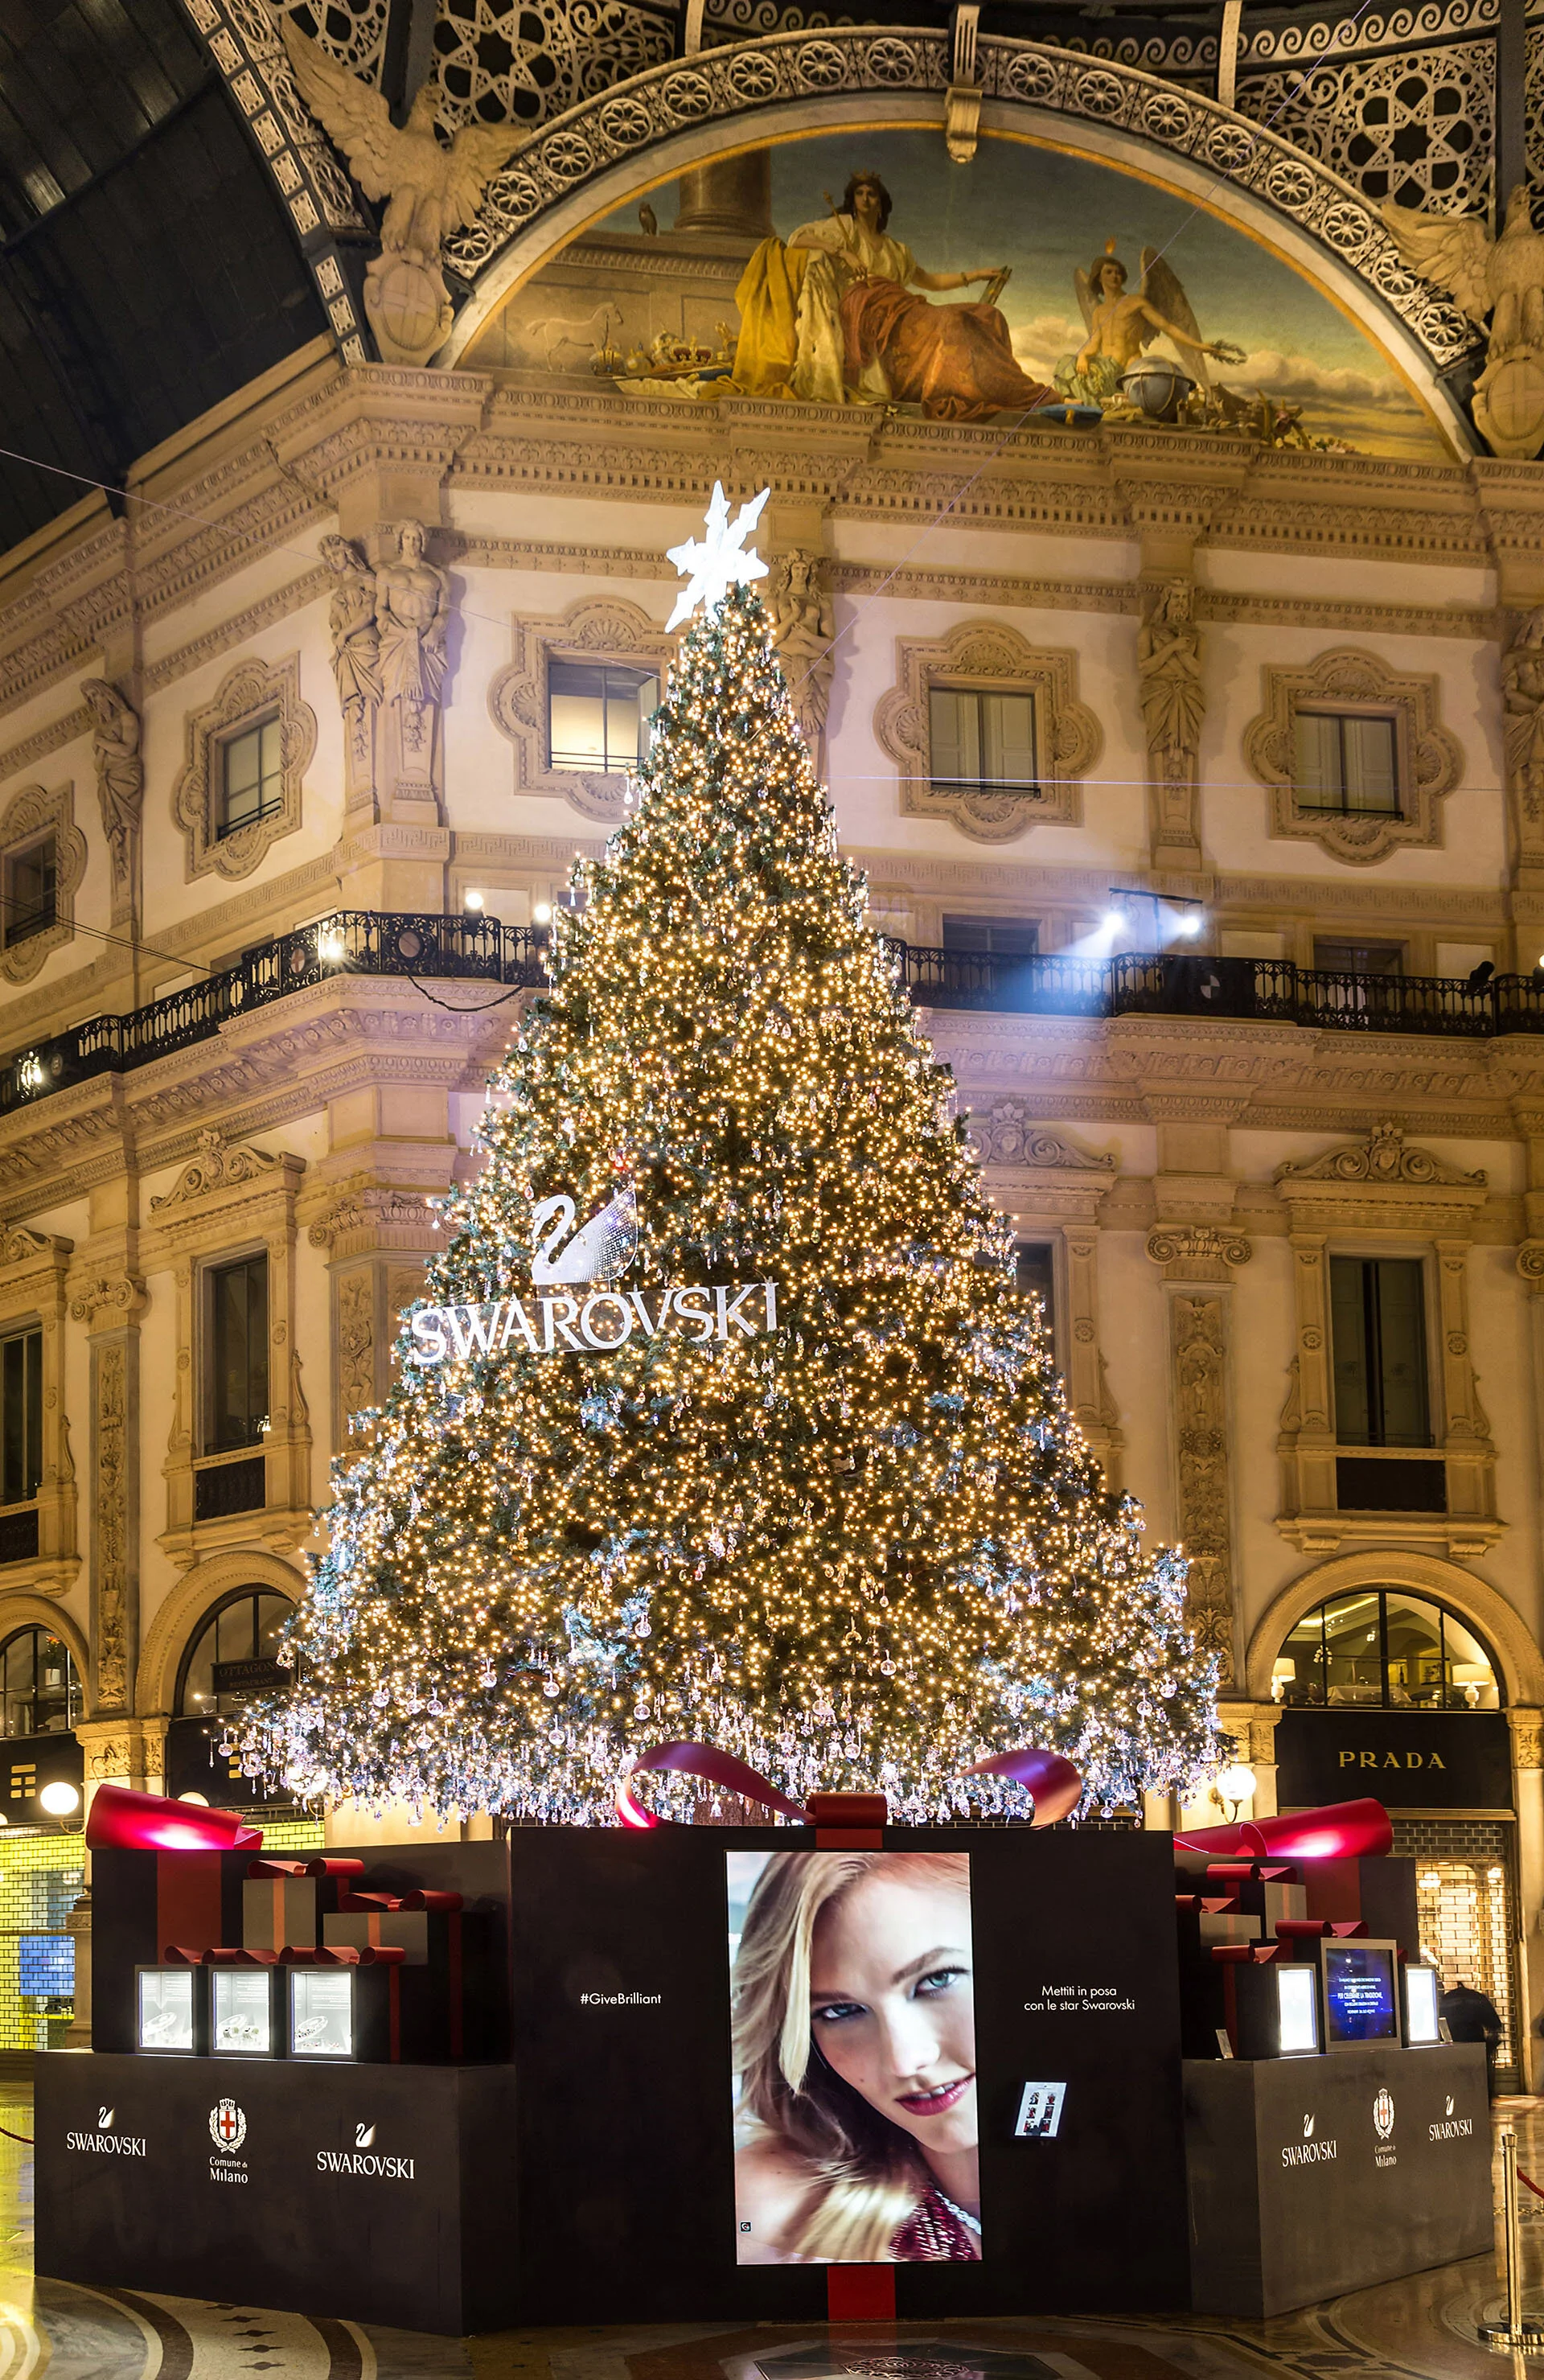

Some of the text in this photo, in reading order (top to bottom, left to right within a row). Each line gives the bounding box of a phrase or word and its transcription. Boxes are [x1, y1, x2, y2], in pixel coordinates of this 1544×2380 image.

[410, 1280, 778, 1365] SWAROVSKI
[1339, 1751, 1446, 1769] PRADA
[581, 1992, 662, 2005] #GiveBrilliant
[1041, 1985, 1117, 1999] Mettiti in posa
[1024, 1998, 1135, 2011] con le star Swarovski
[1428, 2118, 1472, 2141] SWAROVSKI
[66, 2131, 146, 2156] SWAROVSKI
[209, 2156, 241, 2168] Comune
[1281, 2140, 1337, 2168] SWAROVSKI
[1374, 2155, 1397, 2168] Milano
[317, 2151, 415, 2180] SWAROVSKI
[209, 2167, 248, 2184] Milano
